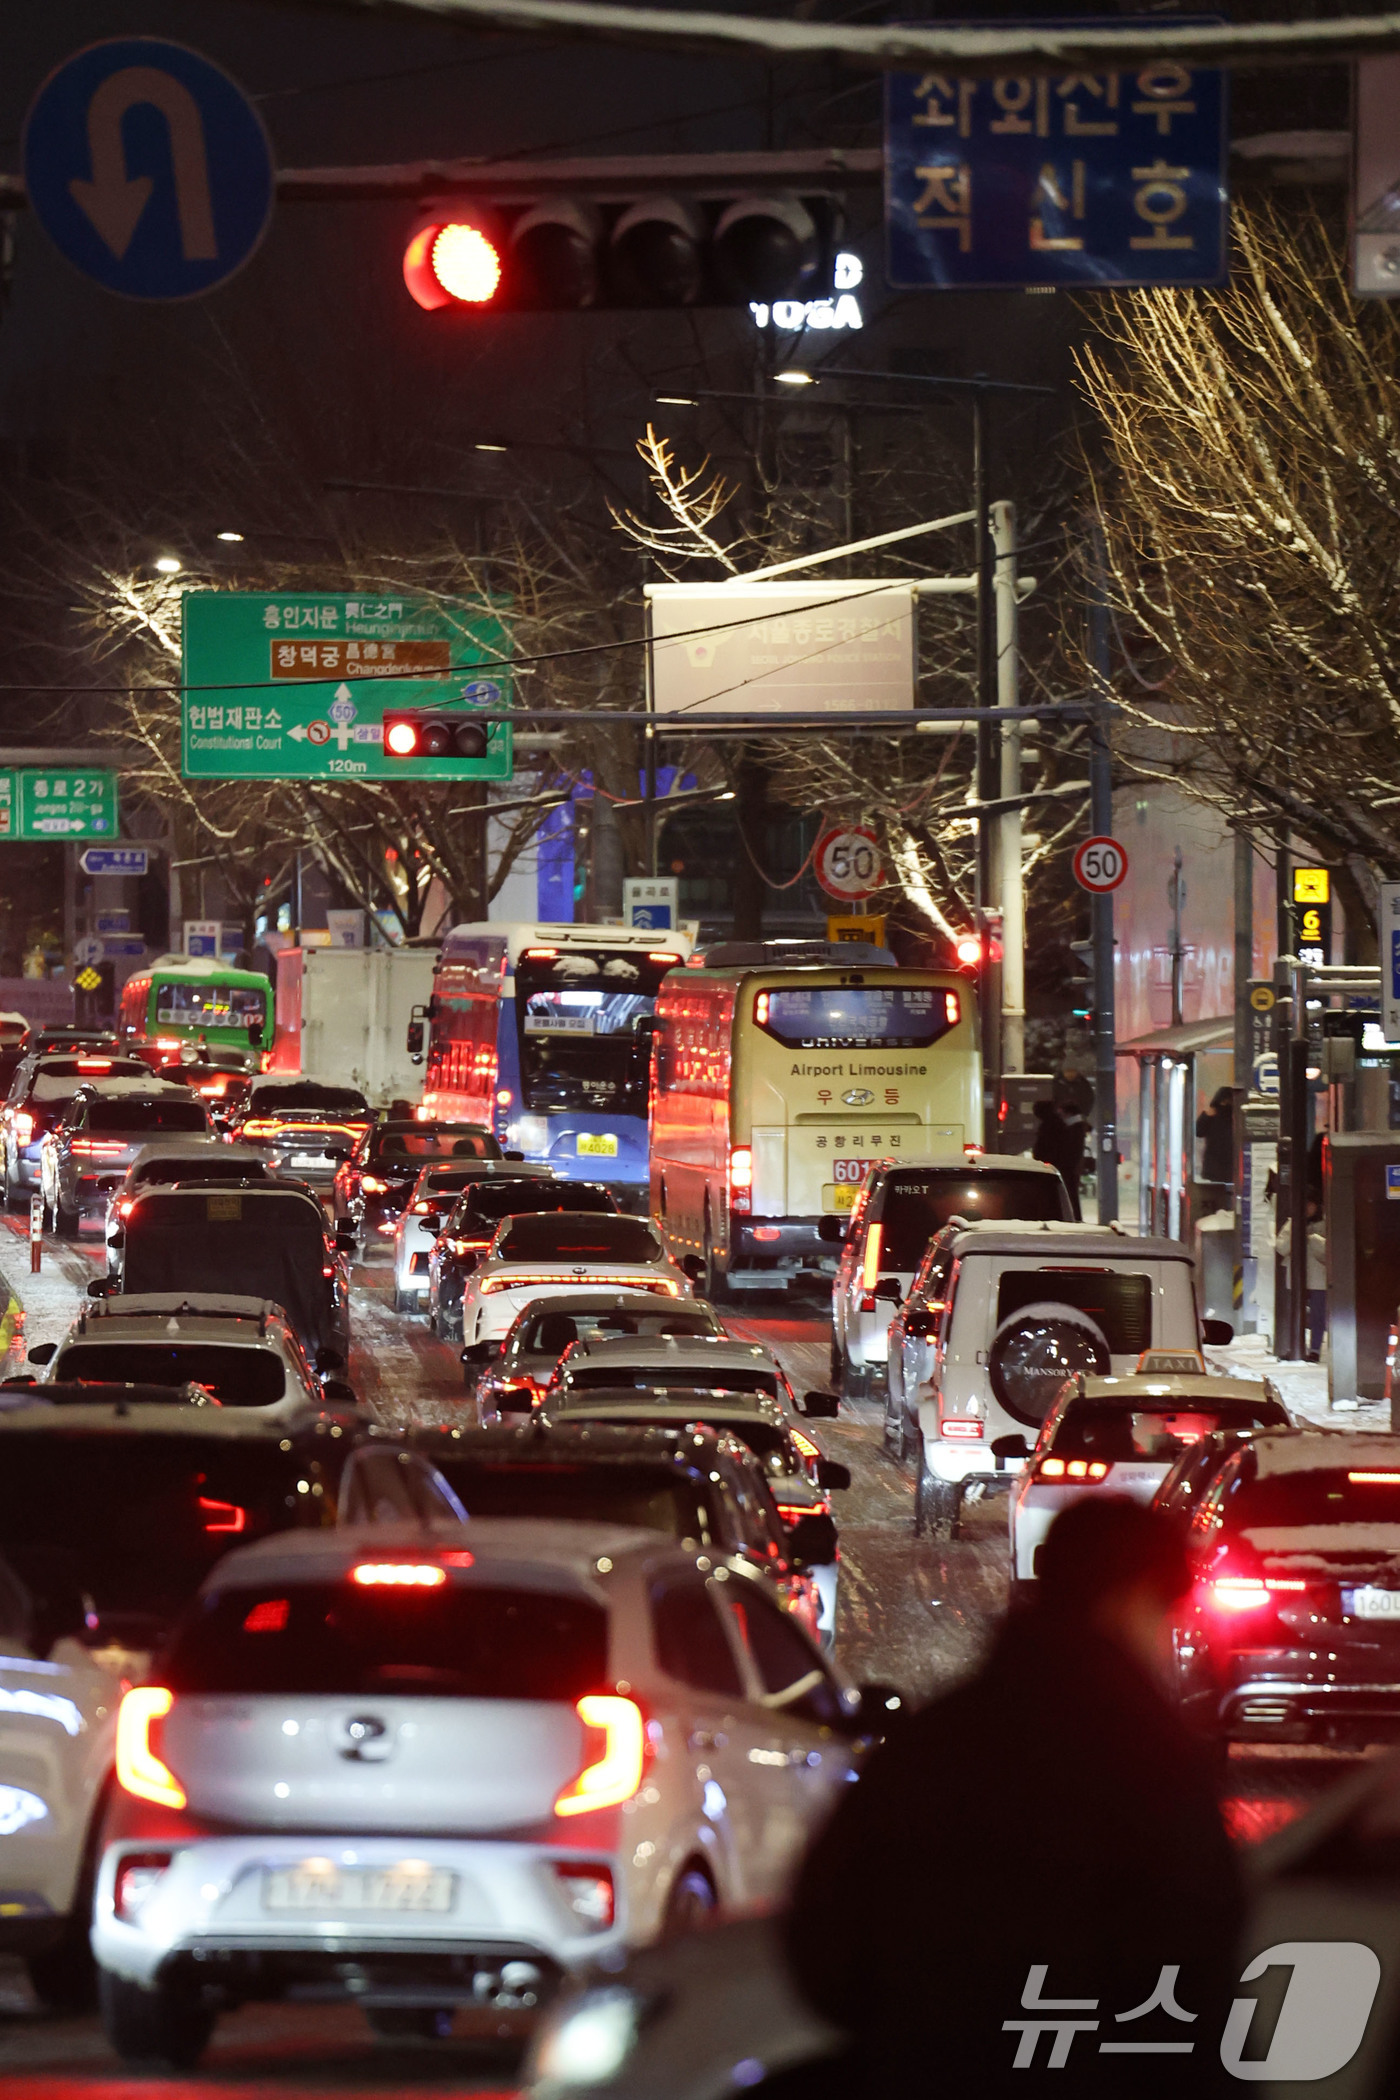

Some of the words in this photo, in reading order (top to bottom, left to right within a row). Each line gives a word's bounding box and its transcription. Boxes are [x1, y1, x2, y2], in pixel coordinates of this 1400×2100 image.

[749, 294, 863, 330] YOGA
[263, 604, 338, 629] 흥인지문
[278, 646, 340, 667] 창덕궁
[188, 705, 282, 731] 헌법재판소
[334, 705, 351, 719] 50
[190, 735, 253, 750] Constitutional
[256, 735, 282, 750] Court
[328, 760, 367, 774] 120m
[831, 846, 873, 880] 50
[1085, 851, 1117, 879] 50
[1303, 909, 1321, 930] 6
[790, 1063, 844, 1077] Airport
[849, 1063, 928, 1077] Limousine
[817, 1089, 832, 1105] 우
[884, 1088, 900, 1105] 등
[816, 1135, 902, 1148] 공항리무진
[1024, 1366, 1075, 1378] MANSORY
[1152, 1358, 1195, 1371] TAXI
